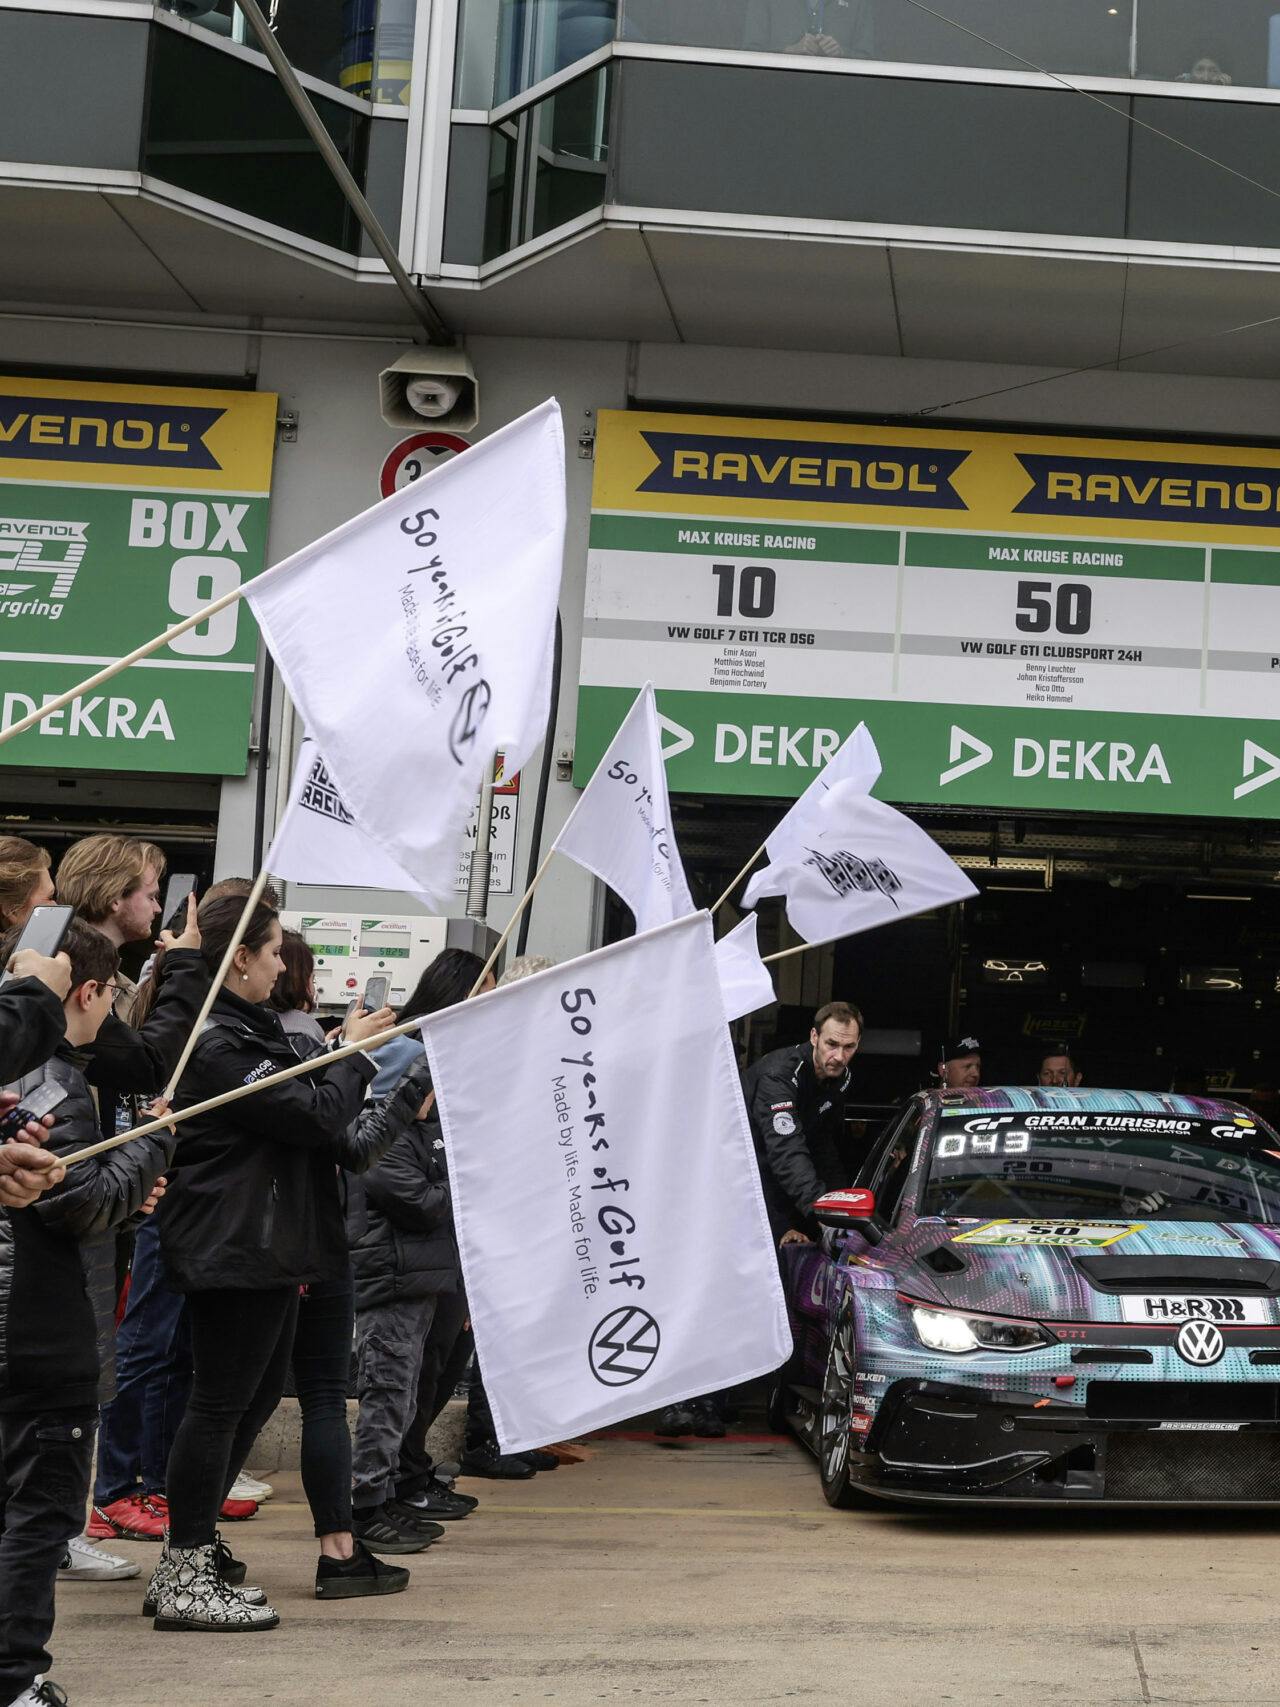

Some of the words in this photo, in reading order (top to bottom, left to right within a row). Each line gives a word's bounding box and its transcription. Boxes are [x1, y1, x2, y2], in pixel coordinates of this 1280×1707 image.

[672, 449, 937, 493] RAVENOL
[128, 498, 250, 552] BOX
[400, 508, 440, 547] 50
[678, 529, 710, 545] MAX
[714, 532, 760, 547] KRUSE
[764, 535, 816, 550] RACING
[988, 547, 1020, 561] MAX
[1024, 549, 1068, 564] KRUSE
[1072, 552, 1124, 567] RACING
[712, 564, 777, 619] 10
[167, 555, 242, 657] 9
[1015, 580, 1092, 635] 50
[667, 626, 690, 639] VW
[693, 628, 725, 641] GOLF
[728, 629, 736, 641] 7
[739, 630, 759, 643] GTI
[762, 632, 786, 644] TCR
[790, 633, 815, 645] DSG
[714, 657, 742, 667] Matthias
[723, 648, 738, 657] Emir
[961, 641, 983, 654] VW
[986, 643, 1017, 656] GOLF
[1020, 644, 1039, 657] GTI
[1043, 645, 1115, 661] CLUBSPORT
[1117, 650, 1142, 662] 24H
[1026, 663, 1047, 674] Benny
[1048, 664, 1076, 674] Leuchter
[710, 677, 741, 688] Benjamin
[1035, 683, 1050, 693] Nico
[1051, 685, 1065, 693] Otto
[1026, 693, 1045, 702] Heiko
[1, 692, 175, 741] DEKRA
[715, 723, 841, 768] DEKR
[607, 759, 638, 785] 50
[1013, 737, 1172, 784] DEKRA
[560, 988, 596, 1036] 50
[250, 1059, 272, 1078] PAGID
[551, 1074, 569, 1124] Made
[1024, 1115, 1089, 1126] GRAN
[1093, 1116, 1191, 1131] TURISMO
[560, 1126, 575, 1148] by
[564, 1149, 578, 1183] life.
[591, 1166, 630, 1192] of
[568, 1184, 584, 1234] Made
[1006, 1236, 1093, 1245] DEKRA
[1028, 1225, 1081, 1236] 50
[575, 1236, 592, 1264] for
[598, 1204, 646, 1290] Golf
[580, 1266, 597, 1300] life.
[1144, 1298, 1208, 1318] H&R
[1057, 1330, 1087, 1338] GTI
